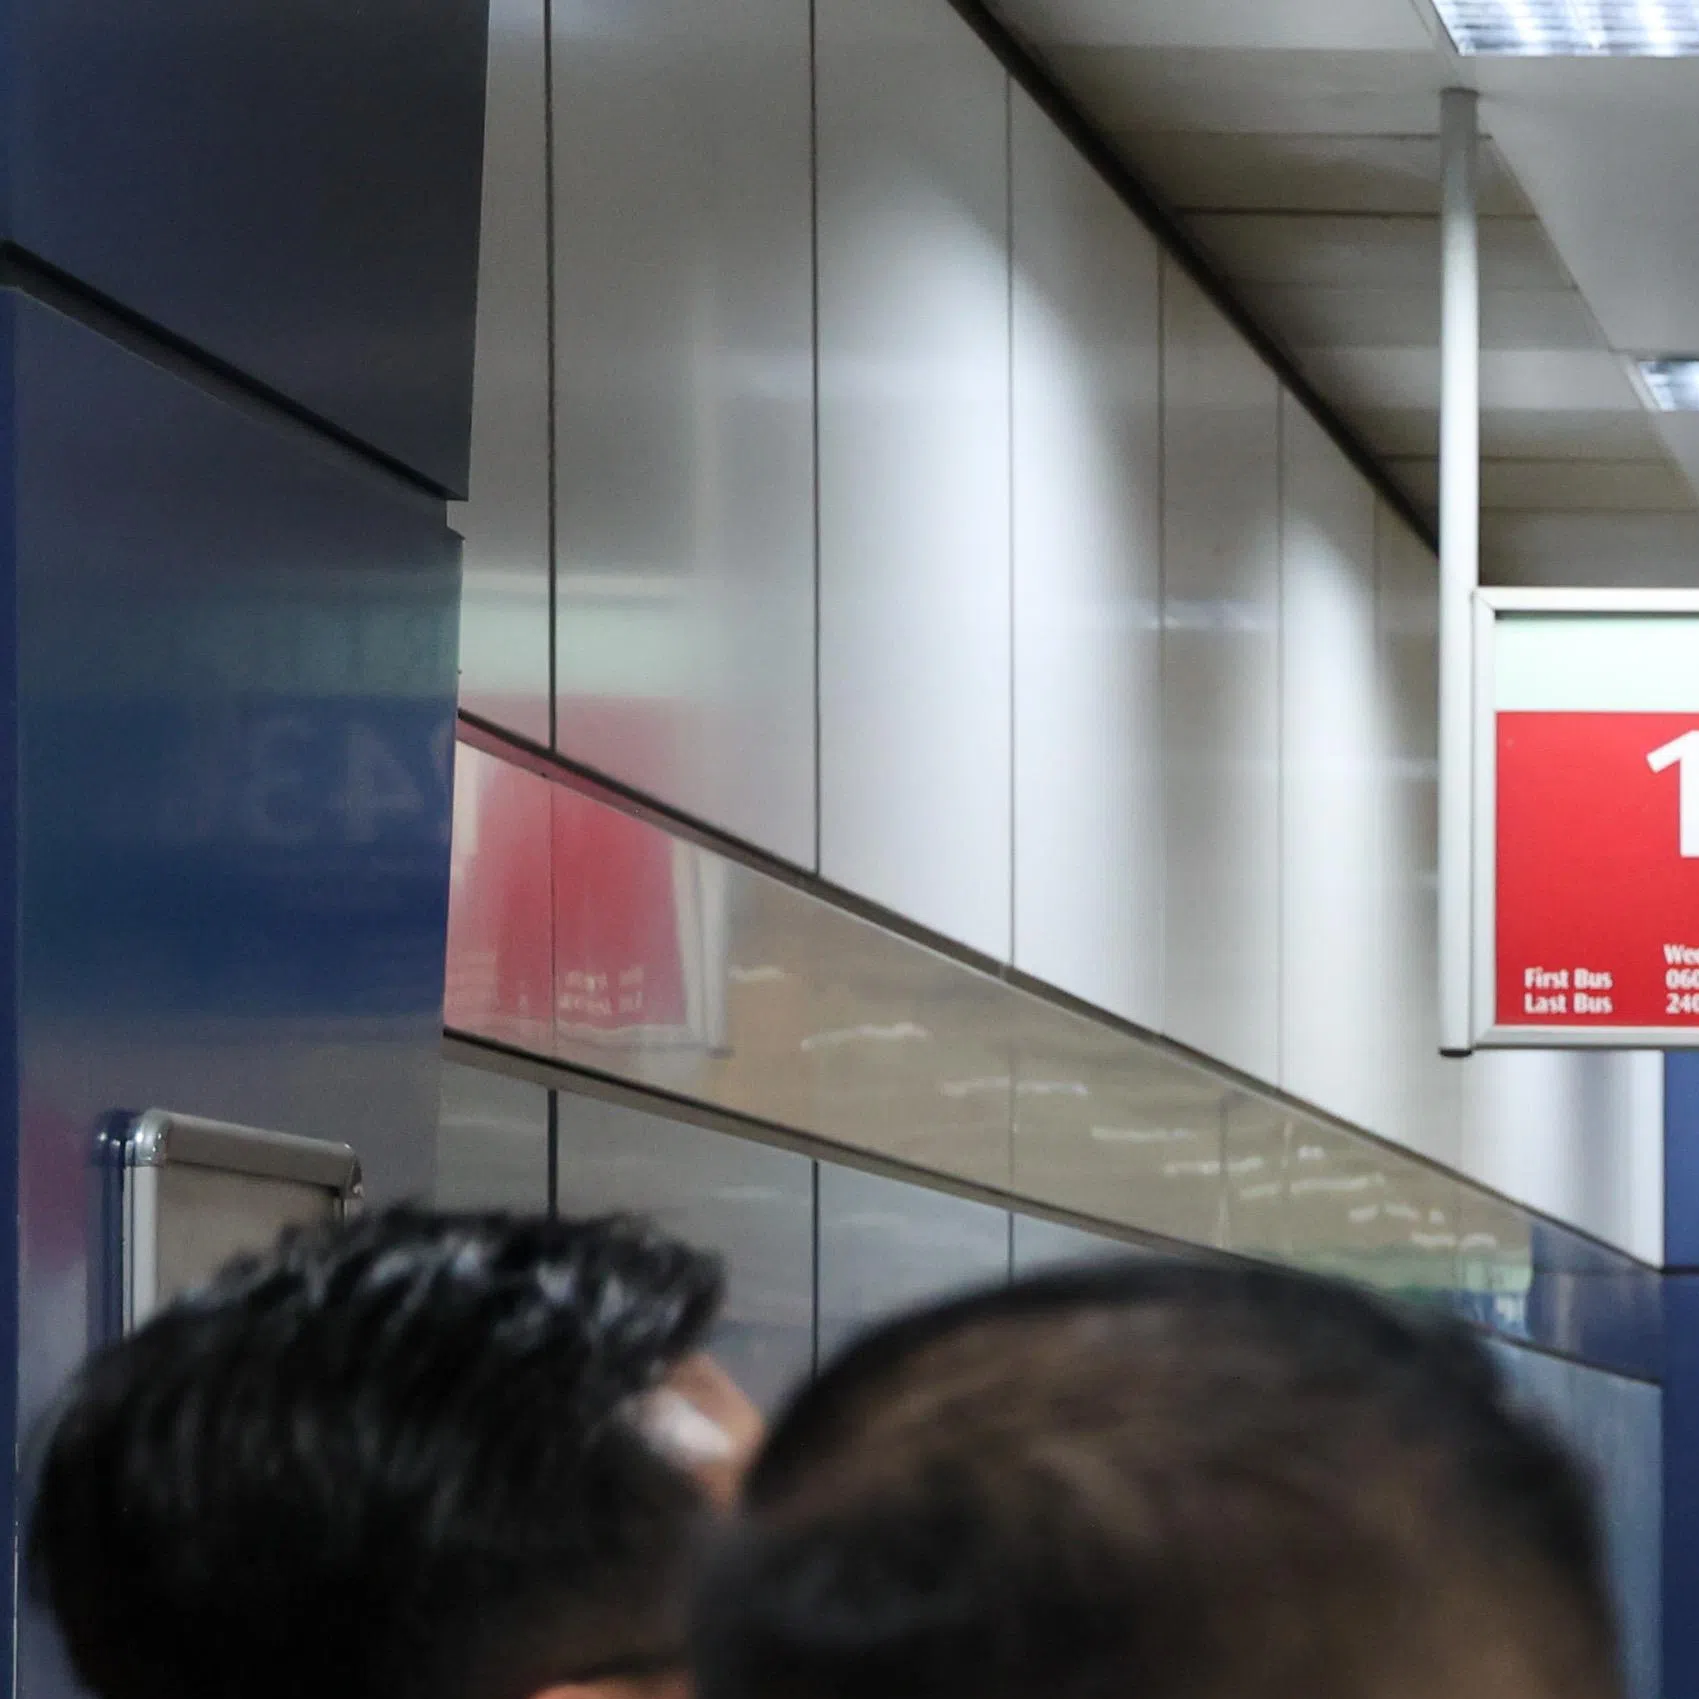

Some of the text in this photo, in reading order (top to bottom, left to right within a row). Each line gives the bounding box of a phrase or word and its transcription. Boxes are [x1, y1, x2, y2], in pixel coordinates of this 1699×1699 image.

[1524, 968, 1569, 989] First
[1573, 969, 1613, 989] Bus
[1524, 994, 1569, 1015] Last
[1573, 994, 1613, 1015] Bus
